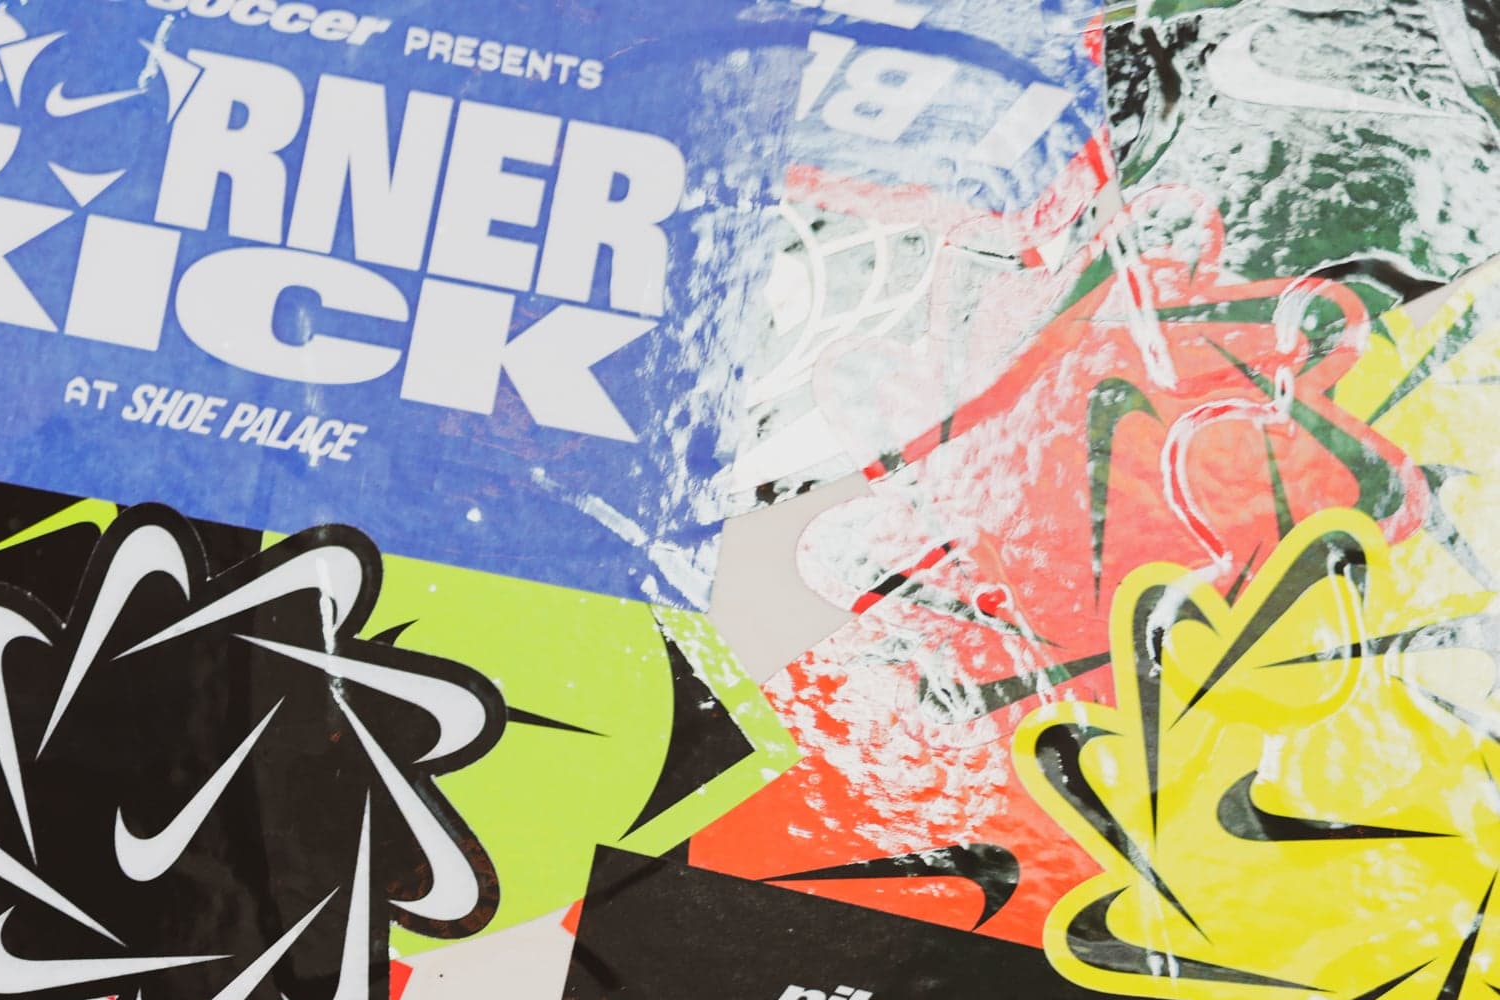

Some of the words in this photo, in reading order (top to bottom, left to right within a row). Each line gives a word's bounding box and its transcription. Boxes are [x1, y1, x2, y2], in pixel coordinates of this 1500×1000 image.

[404, 27, 605, 90] PRESENTS
[64, 376, 118, 410] AT
[121, 383, 228, 435] SHOE
[219, 403, 368, 463] PALACE
